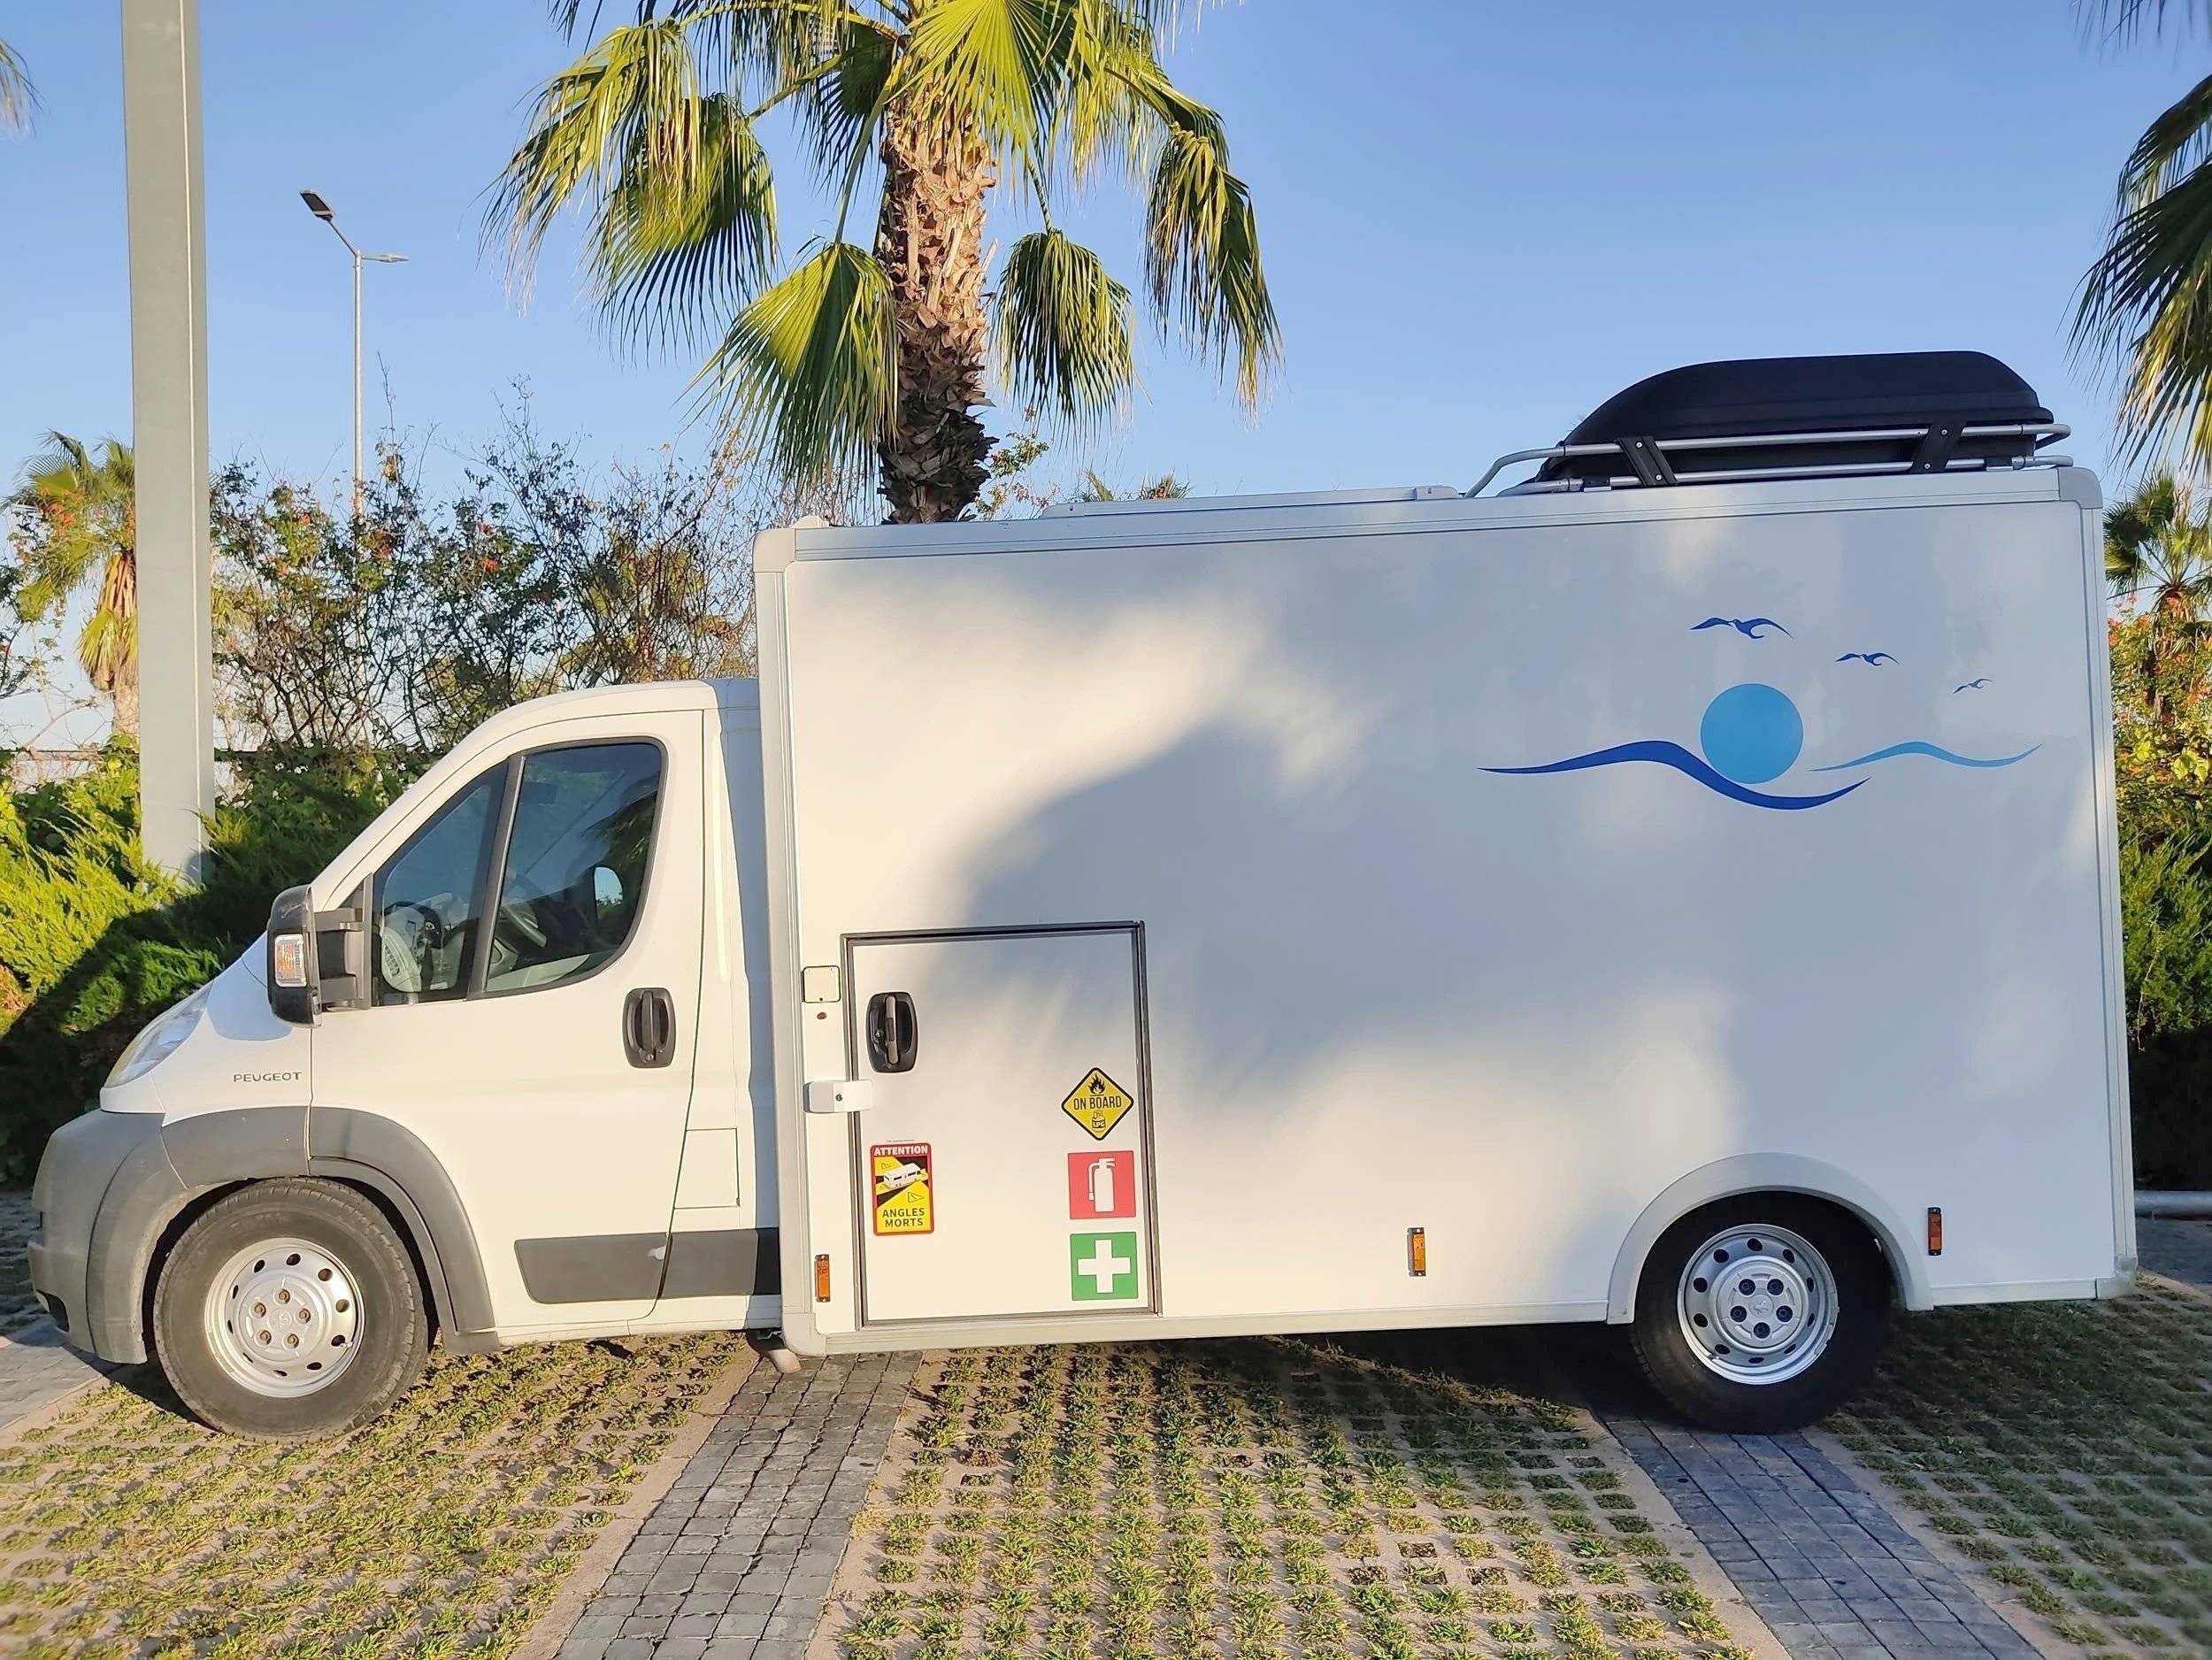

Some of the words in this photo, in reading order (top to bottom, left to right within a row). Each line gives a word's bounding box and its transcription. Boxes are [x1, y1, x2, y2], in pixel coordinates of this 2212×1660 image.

[233, 1072, 302, 1082] PEUGEOT
[1073, 1097, 1087, 1111] ON
[1089, 1095, 1122, 1109] BOARD
[874, 1145, 928, 1156] ATTENTION
[882, 1207, 925, 1218] ANGLES
[885, 1218, 924, 1227] MORTS
